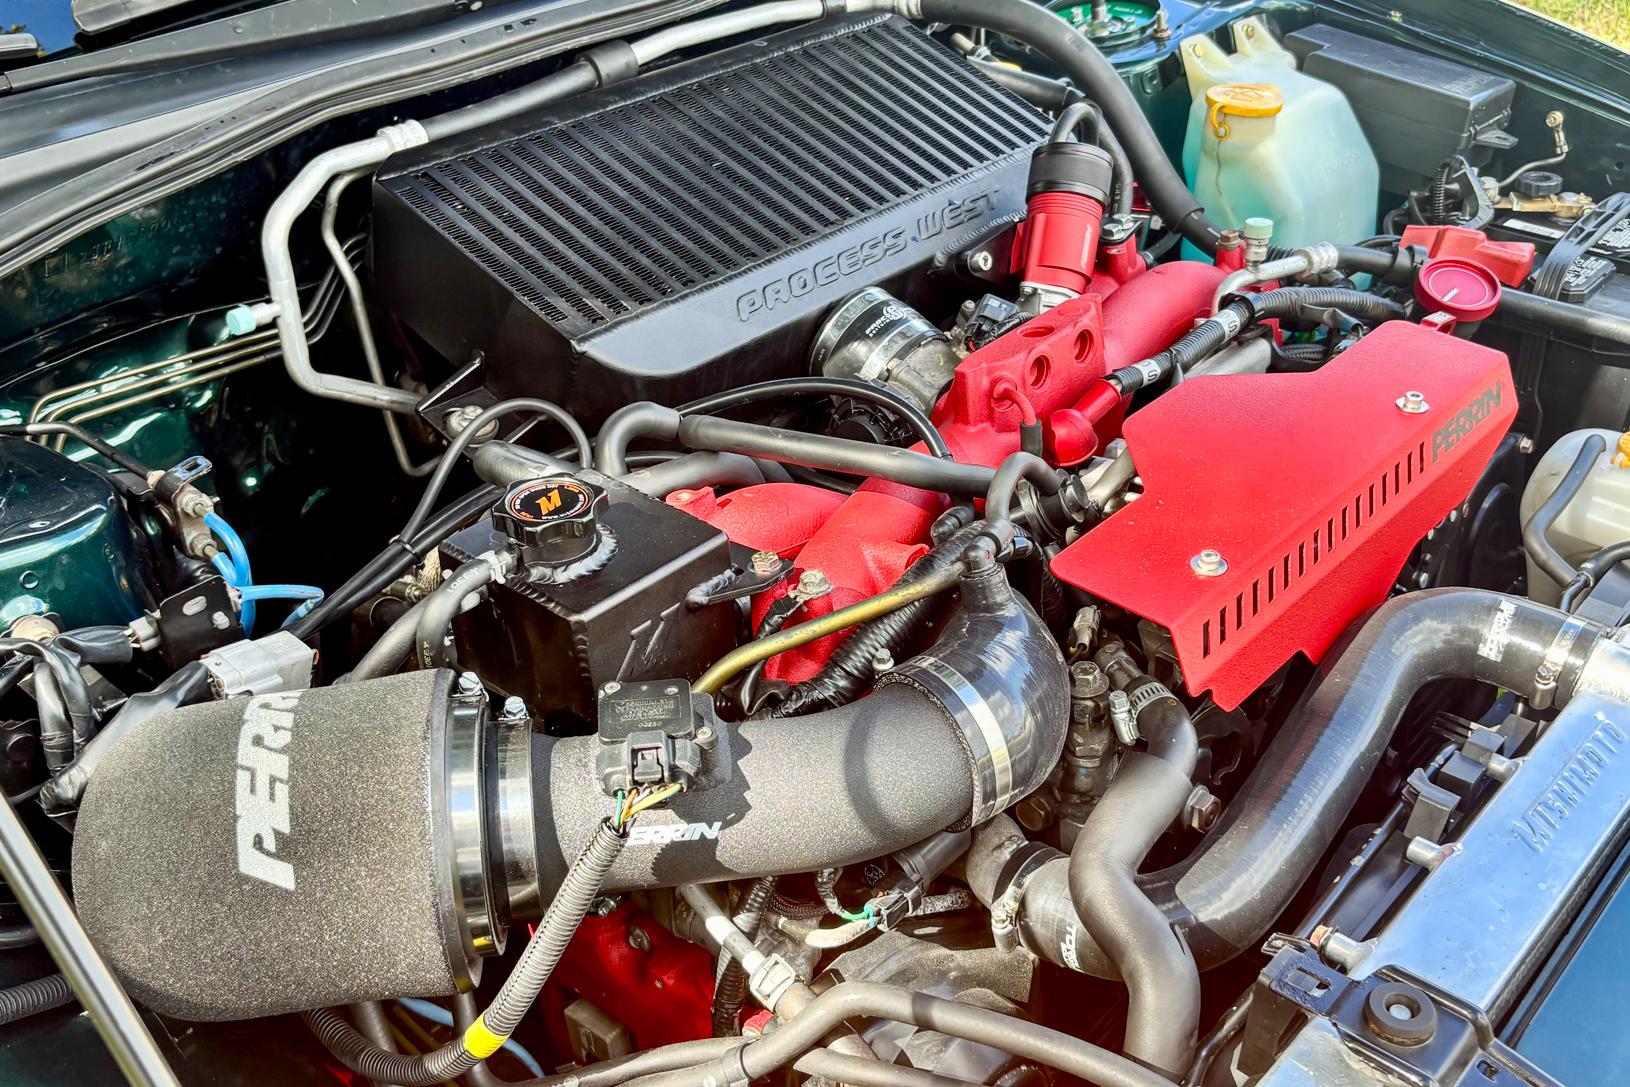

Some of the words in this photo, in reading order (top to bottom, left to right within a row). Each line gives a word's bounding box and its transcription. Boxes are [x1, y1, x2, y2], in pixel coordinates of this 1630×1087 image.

[736, 226, 908, 323] PROCESS
[917, 185, 1000, 241] WEST
[1432, 379, 1502, 464] PERRIN
[624, 821, 723, 848] ERRIN
[1511, 719, 1627, 853] MISHIMOTO
